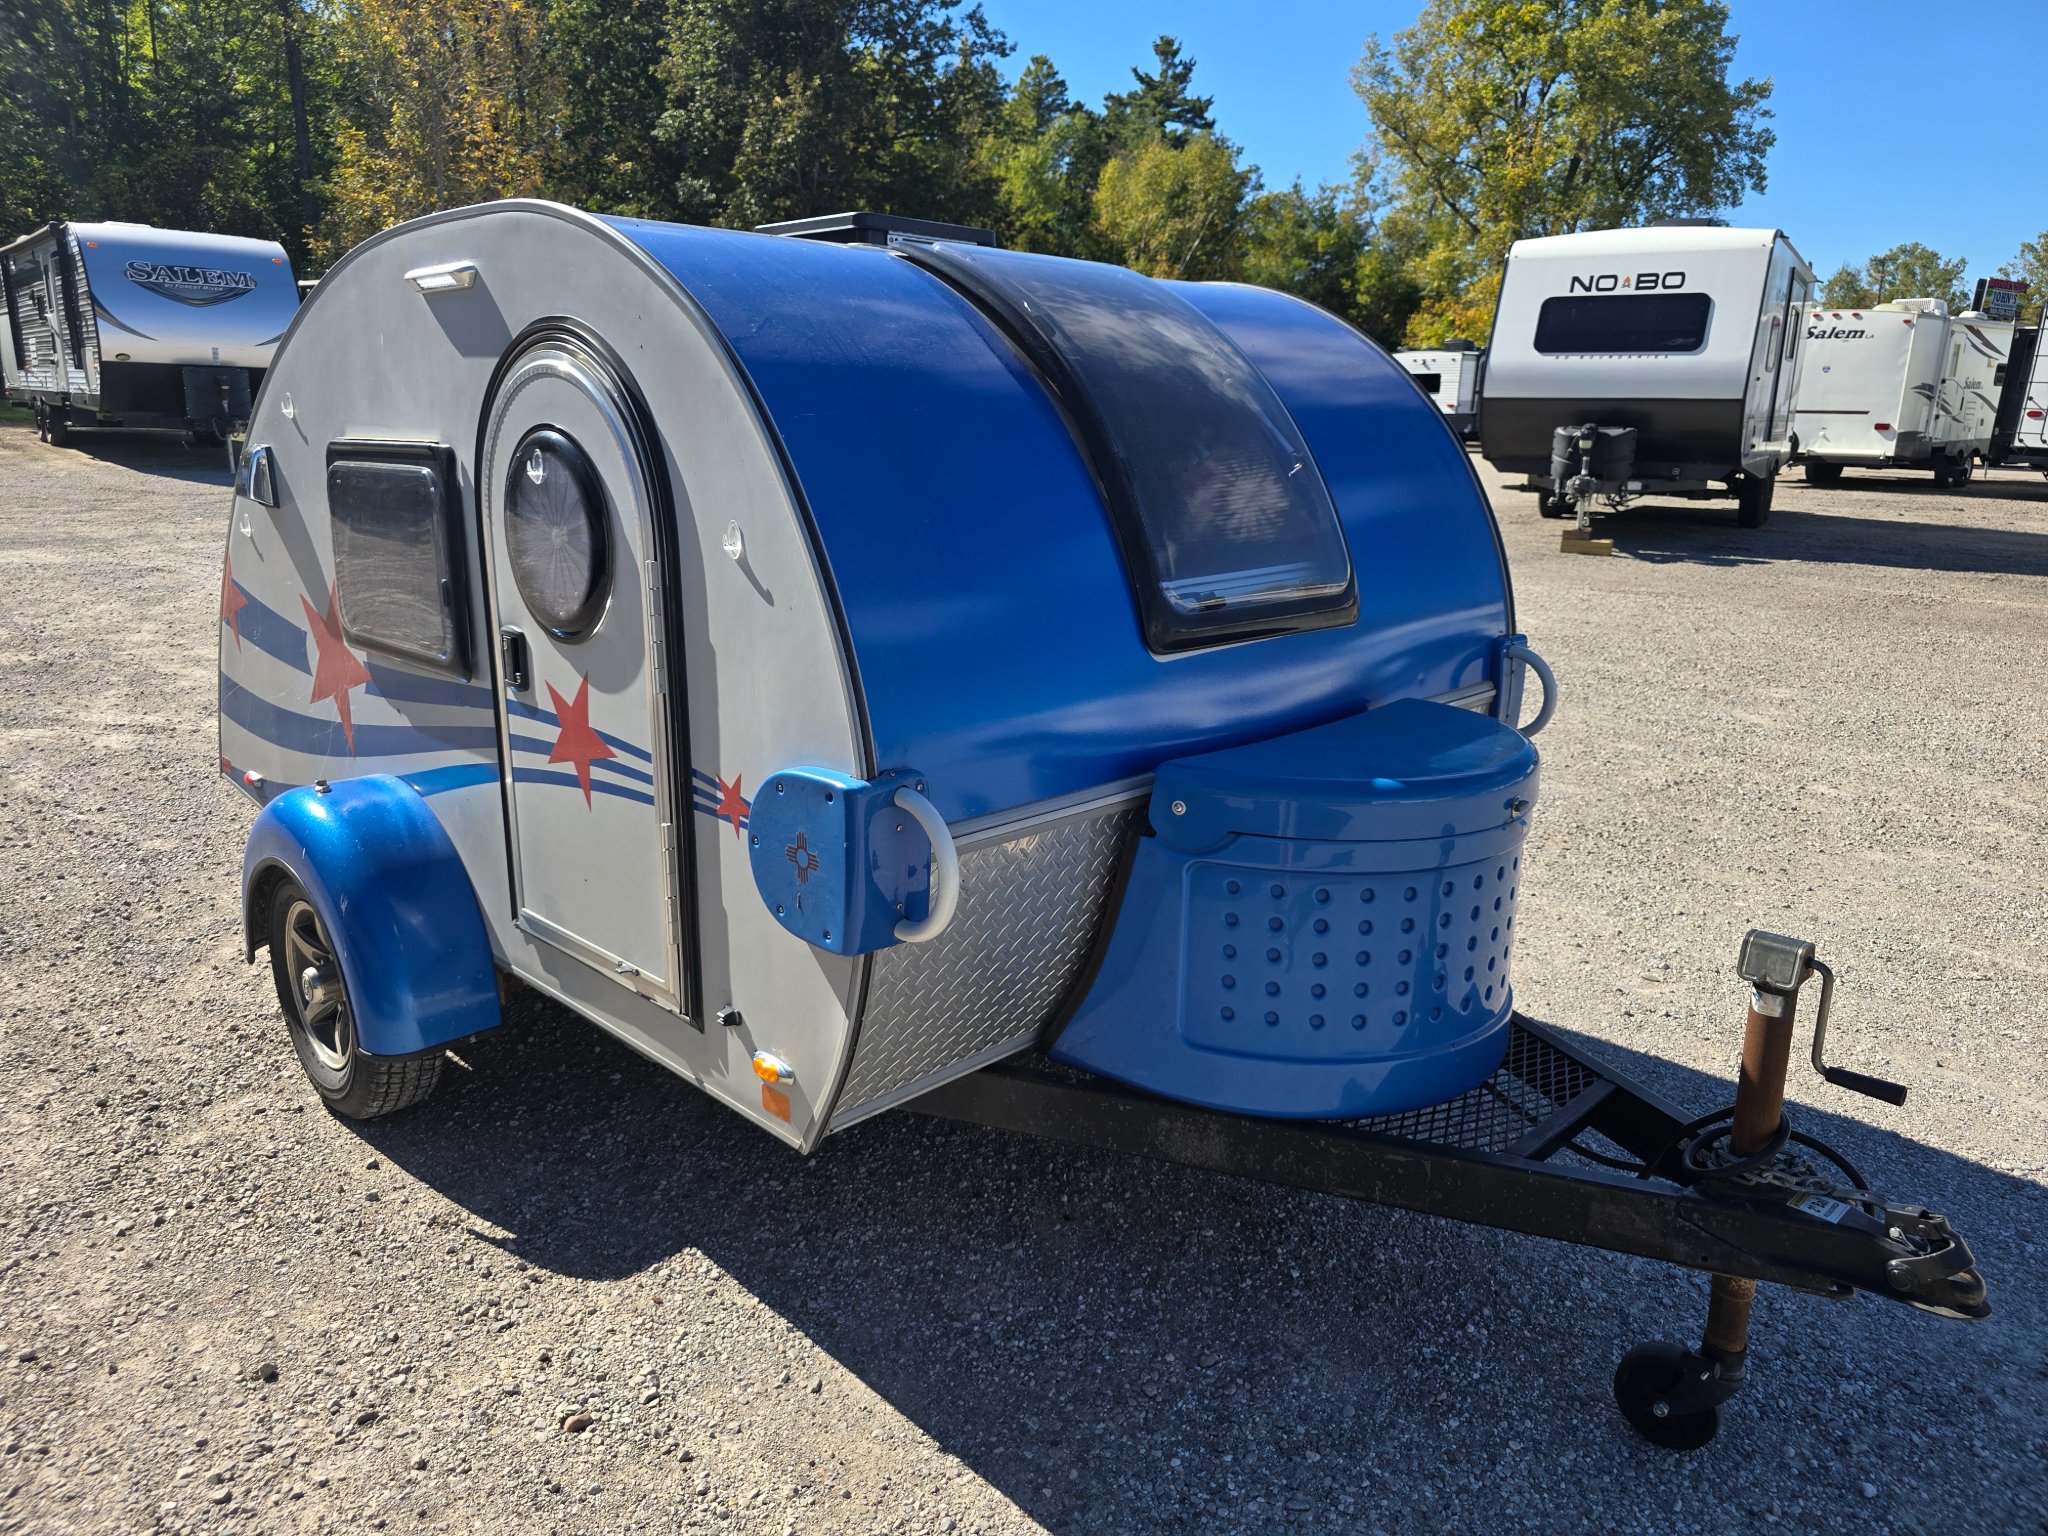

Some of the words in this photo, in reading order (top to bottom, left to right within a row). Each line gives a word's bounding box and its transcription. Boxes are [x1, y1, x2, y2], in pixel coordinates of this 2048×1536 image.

[126, 260, 256, 289] SALEM
[1992, 290, 2018, 304] JOHN'S
[1806, 325, 1866, 340] Salem
[1963, 377, 1982, 390] Salem
